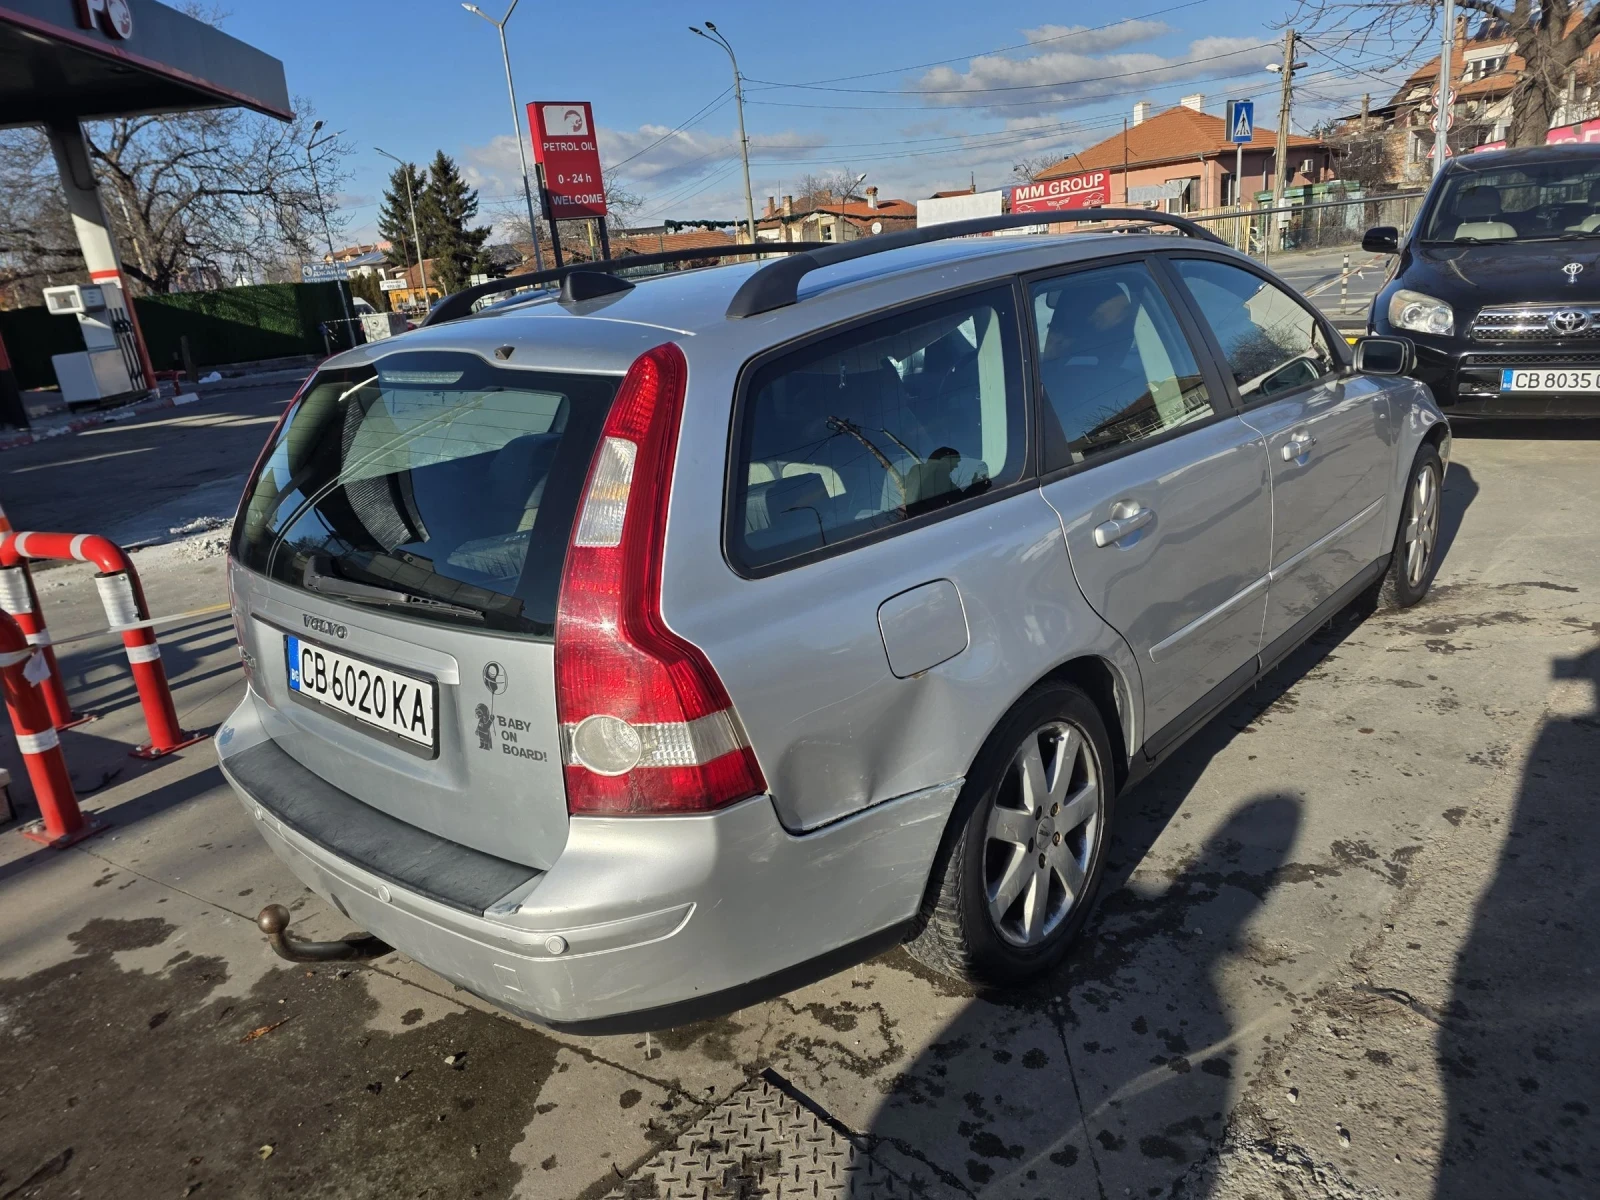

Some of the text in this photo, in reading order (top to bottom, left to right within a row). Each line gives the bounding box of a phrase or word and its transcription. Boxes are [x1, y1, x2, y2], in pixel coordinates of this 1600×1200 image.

[543, 141, 596, 151] PETROL OIL
[573, 174, 584, 183] 24
[586, 173, 592, 182] h
[1016, 173, 1104, 200] MM GROUP
[553, 194, 603, 205] WELCOME
[1515, 373, 1540, 389] CB
[1544, 373, 1591, 389] 8035
[302, 613, 348, 639] VOLVO
[291, 668, 300, 682] BG
[496, 715, 531, 732] BABY
[501, 730, 518, 743] ON
[502, 743, 548, 762] BOARD!
